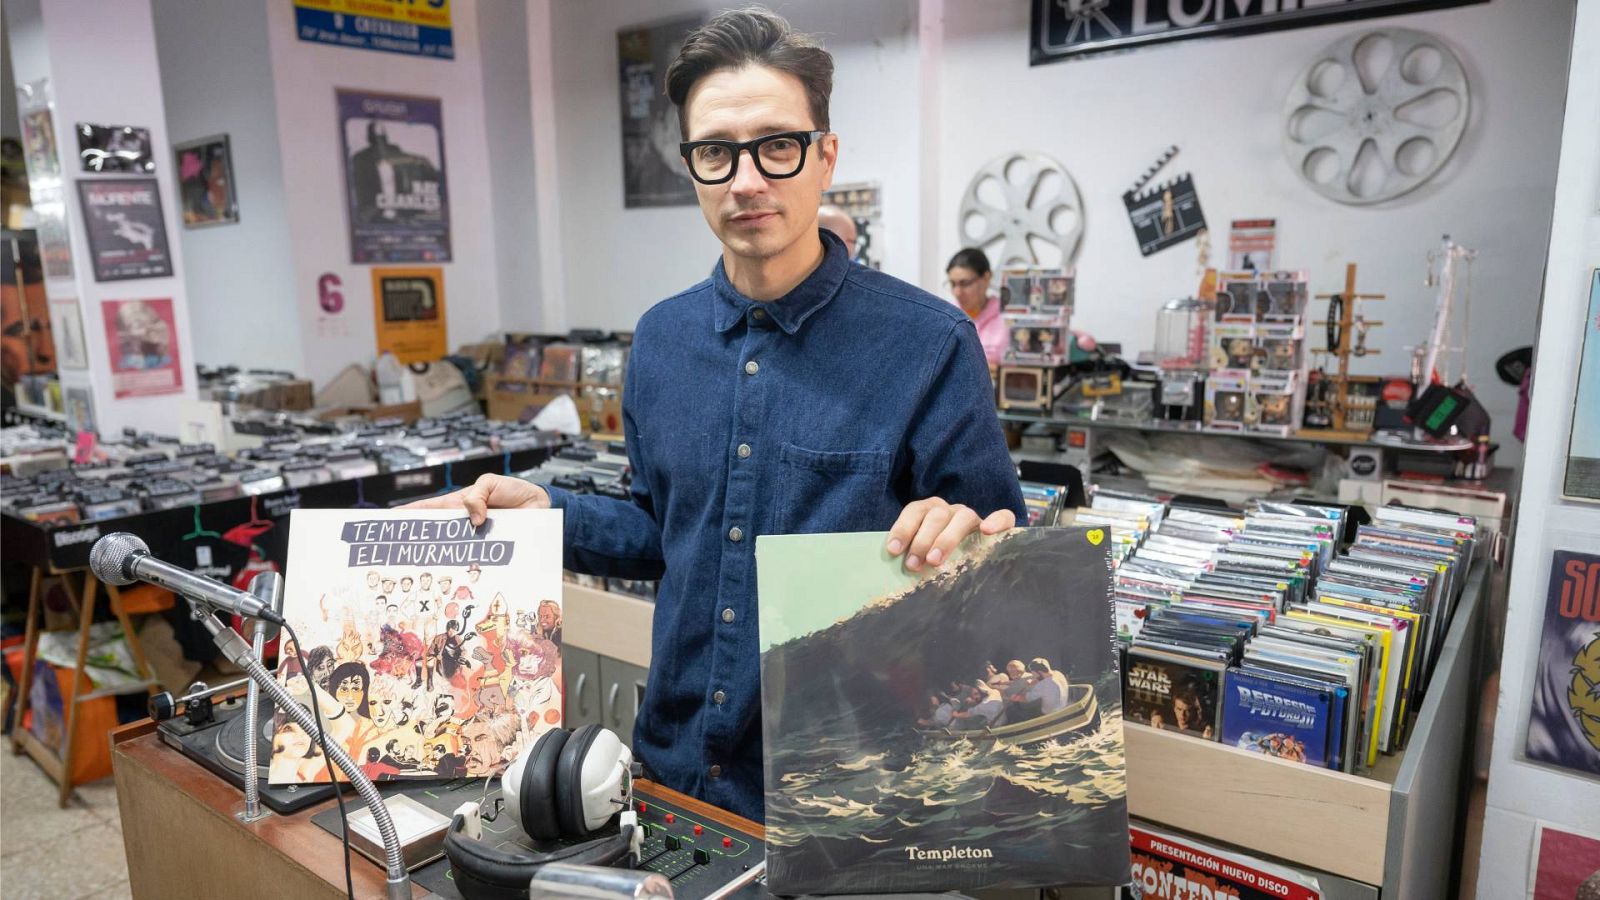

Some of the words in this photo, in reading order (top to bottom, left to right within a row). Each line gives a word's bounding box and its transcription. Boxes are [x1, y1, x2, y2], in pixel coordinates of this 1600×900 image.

[353, 519, 477, 542] TEMPLETON
[356, 546, 383, 565] EL
[397, 542, 506, 564] MURMULLO
[1128, 667, 1171, 685] STAR
[1128, 676, 1171, 695] WARS
[904, 845, 993, 862] Templeton
[1150, 839, 1220, 872] PRESENTACIÓN
[1222, 864, 1256, 884] NUEVO
[1257, 876, 1289, 896] DISCO
